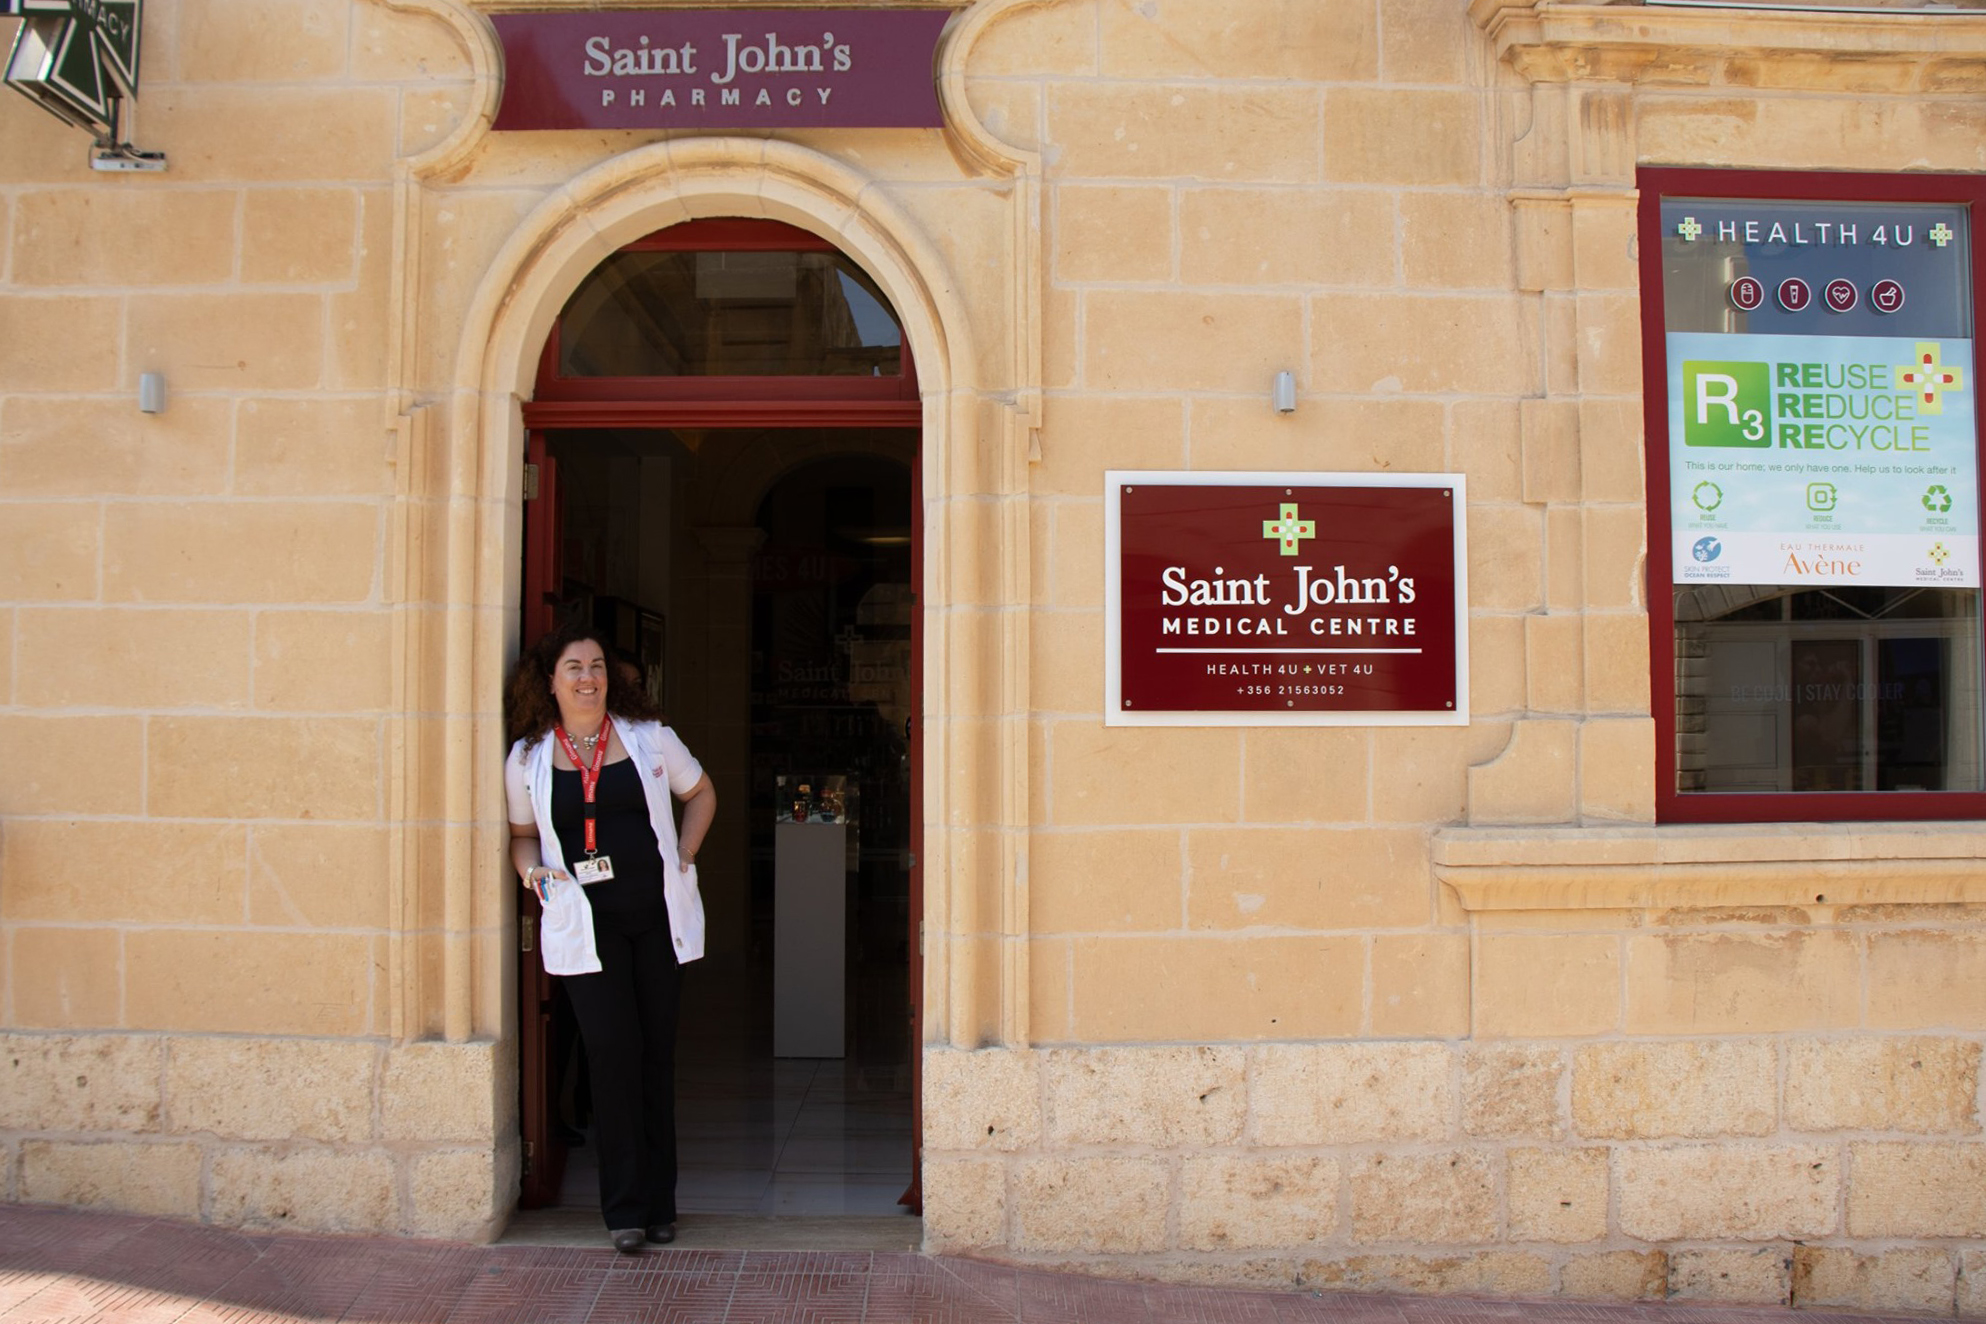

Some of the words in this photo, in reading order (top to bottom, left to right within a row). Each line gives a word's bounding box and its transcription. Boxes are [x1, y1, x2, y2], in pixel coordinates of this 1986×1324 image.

[584, 36, 697, 77] Saint
[711, 32, 852, 84] John's
[602, 88, 832, 107] PHARMACY
[1718, 220, 1858, 245] HEALTH
[1872, 225, 1914, 247] 4U
[1776, 362, 1889, 390] REUSE
[1777, 393, 1915, 421] REDUCE
[1778, 424, 1931, 451] RECYCLE
[1685, 461, 1706, 470] This
[1707, 461, 1716, 470] is
[1718, 463, 1733, 471] our
[1768, 464, 1782, 472] we
[1784, 463, 1805, 474] only
[1806, 463, 1830, 473] have
[1831, 465, 1852, 473] one.
[1854, 464, 1877, 475] Help
[1879, 466, 1890, 474] us
[1892, 465, 1902, 474] to
[1904, 465, 1923, 475] look
[1926, 465, 1948, 475] after
[1950, 466, 1957, 475] it
[1780, 543, 1802, 551] EAU
[1783, 552, 1861, 576] Avène
[1915, 568, 1936, 576] Saint
[1162, 566, 1271, 606] Saint
[1284, 565, 1416, 615] John's
[1162, 618, 1288, 635] MEDICAL
[1310, 618, 1416, 635] CENTRE
[1207, 664, 1272, 675] HEALTH
[1278, 664, 1298, 675] 4U
[1317, 664, 1347, 675] VET
[1353, 664, 1373, 675] 4U
[1237, 685, 1271, 695] +356
[1278, 685, 1344, 695] 21563052
[1805, 684, 1841, 702] STAY
[1846, 682, 1904, 701] COOLER
